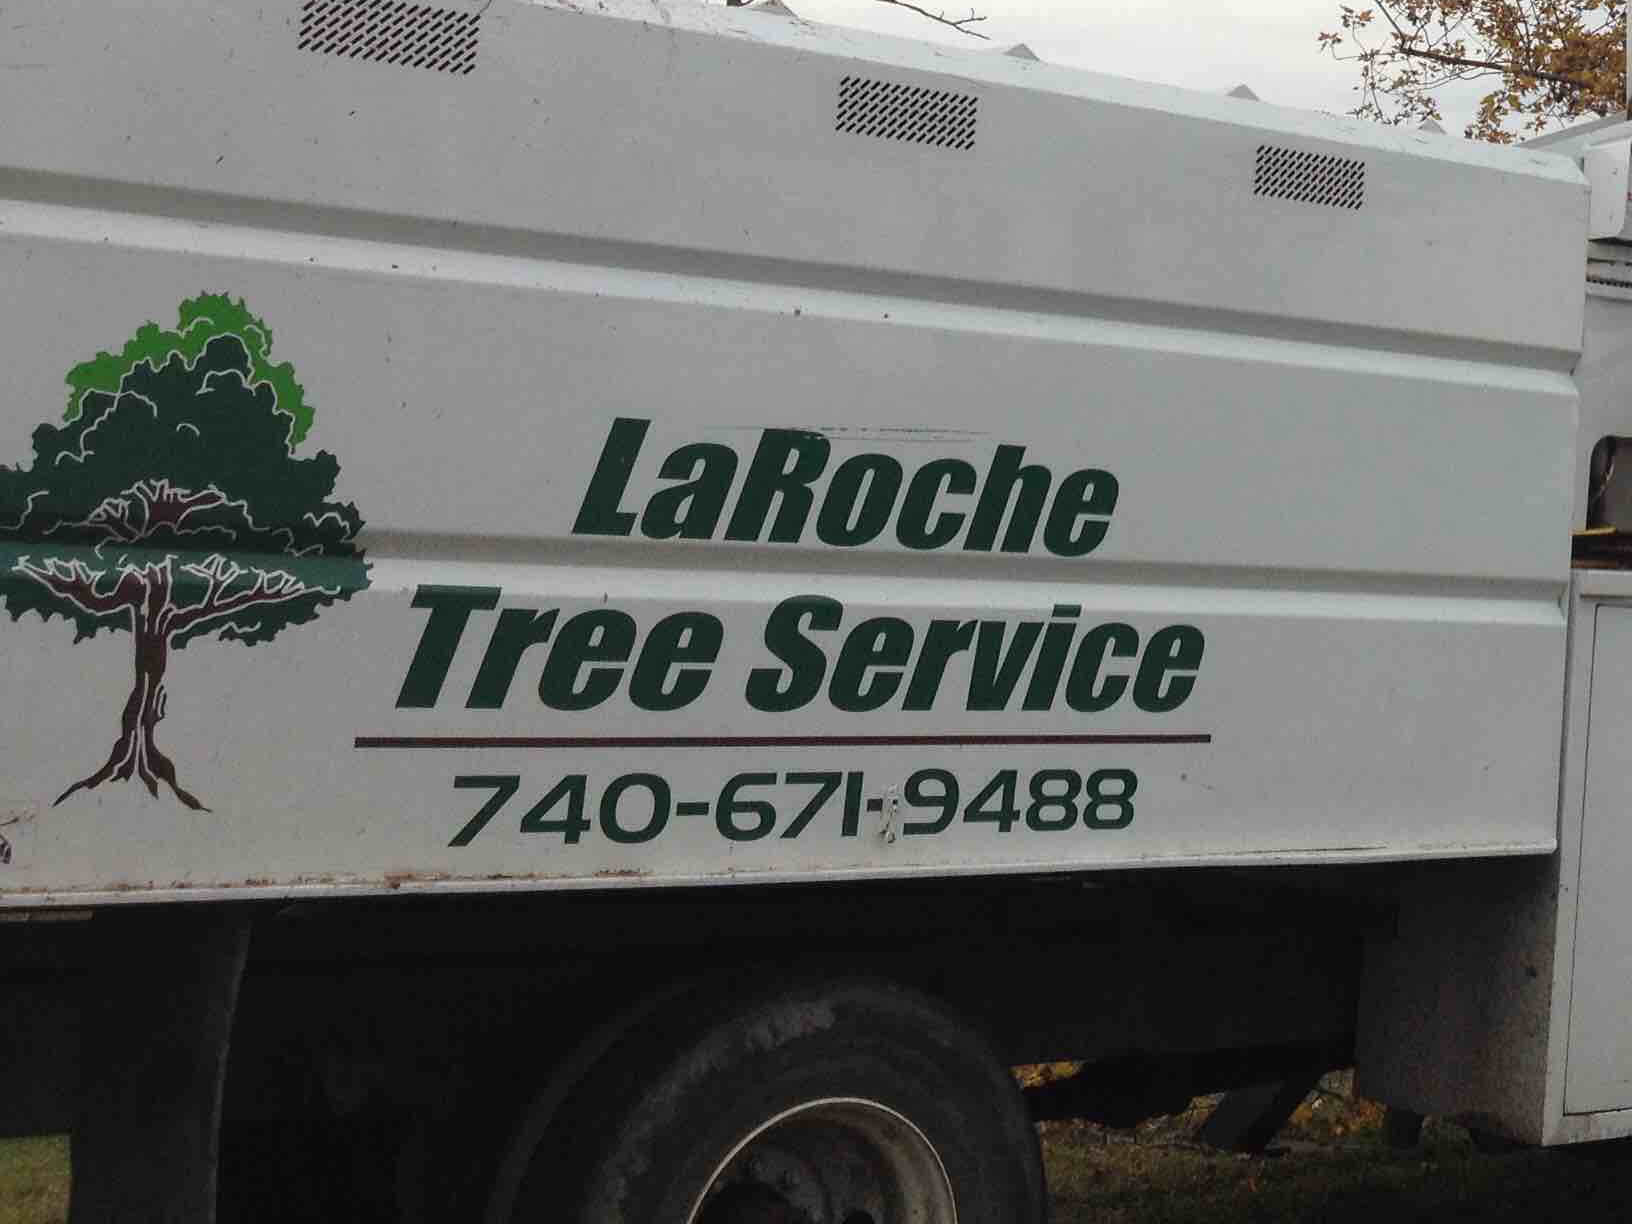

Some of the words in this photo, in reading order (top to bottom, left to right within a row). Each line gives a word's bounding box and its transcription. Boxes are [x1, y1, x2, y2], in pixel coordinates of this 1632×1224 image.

[572, 417, 1119, 557] LaRoche
[395, 584, 723, 712] Tree
[744, 595, 1204, 713] Service
[448, 768, 1138, 848] 740-671-9488
